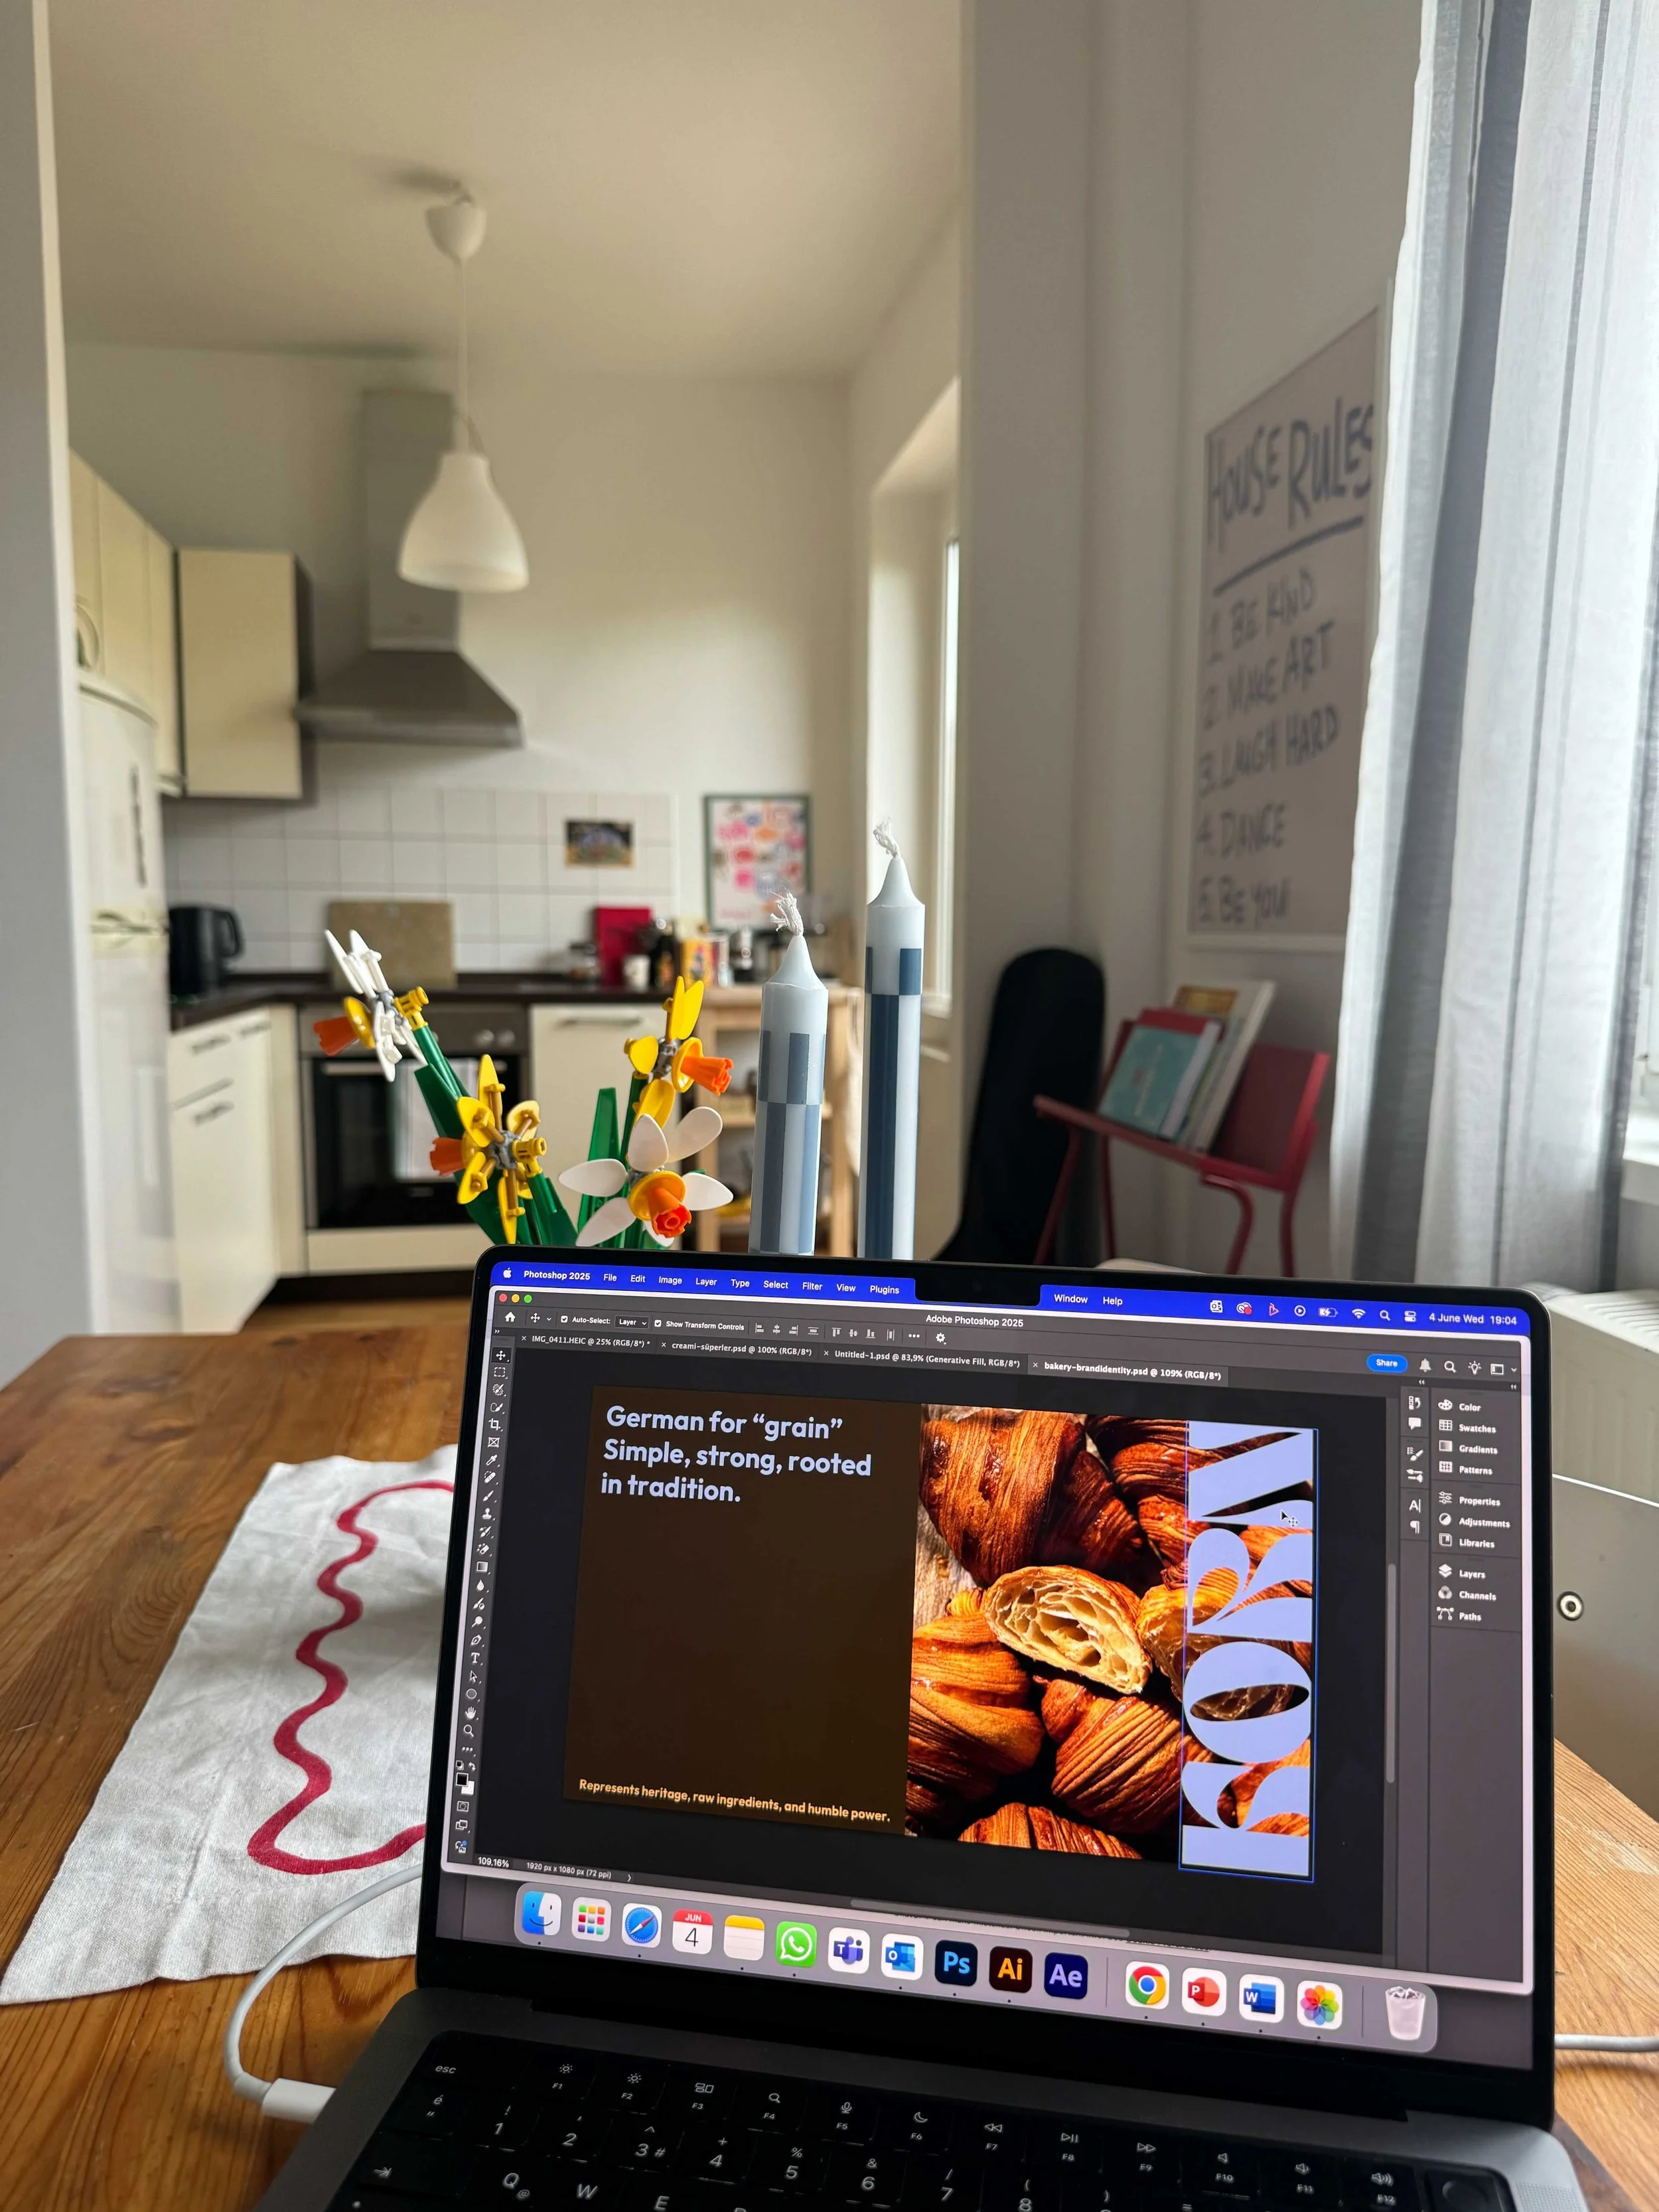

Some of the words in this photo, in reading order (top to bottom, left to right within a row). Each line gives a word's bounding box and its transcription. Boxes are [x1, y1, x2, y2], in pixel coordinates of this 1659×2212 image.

[1206, 425, 1281, 553] HOUSE
[1287, 398, 1373, 530] RULES
[524, 1270, 567, 1280] Photoshop
[569, 1272, 591, 1280] 2025
[658, 1276, 683, 1286] Image
[695, 1278, 717, 1287] Layer
[731, 1279, 750, 1289] Type
[763, 1280, 788, 1290] Select
[802, 1282, 823, 1291] Filter
[836, 1284, 856, 1292] View
[870, 1285, 900, 1295] Plugins
[1054, 1293, 1088, 1303] Window
[1103, 1296, 1123, 1307] Help
[572, 1316, 611, 1325] Auto-Select:
[619, 1319, 637, 1327] Layer
[926, 1314, 952, 1323] Adobe
[955, 1315, 999, 1327] Photoshop
[1001, 1318, 1024, 1327] 2025
[1429, 1312, 1436, 1322] 4
[1437, 1313, 1460, 1323] June
[1463, 1314, 1484, 1324] Wed
[1490, 1315, 1517, 1325] 19:04
[532, 1335, 586, 1345] IMG_0411.HEIC
[757, 1346, 777, 1355] 100%
[835, 1351, 890, 1361] Untitled-1.psd
[926, 1355, 970, 1364] (Generative
[972, 1357, 986, 1366] Fill,
[1376, 1359, 1398, 1367] Share
[1045, 1362, 1148, 1376] bakery-brandidentity.psd
[1459, 1403, 1482, 1412] Color
[607, 1405, 704, 1432] German
[709, 1410, 747, 1434] for
[1459, 1424, 1496, 1434] Swatches
[1459, 1445, 1498, 1455] Gradients
[603, 1438, 691, 1469] Simple,
[695, 1445, 782, 1475] strong,
[788, 1453, 872, 1476] rooted
[1459, 1466, 1492, 1475] Patterns
[601, 1472, 622, 1494] in
[627, 1474, 741, 1502] tradition.
[1459, 1496, 1501, 1507] Properties
[1459, 1517, 1510, 1528] Adjustments
[1459, 1538, 1495, 1548] Libraries
[1459, 1570, 1486, 1580] Layers
[1459, 1591, 1496, 1601] Channels
[1459, 1612, 1482, 1621] Paths
[579, 1779, 640, 1795] Represents
[642, 1785, 691, 1803] heritage,
[693, 1793, 715, 1803] raw
[717, 1793, 782, 1812] ingredients,
[784, 1802, 806, 1813] and
[808, 1803, 849, 1818] humble
[851, 1809, 891, 1822] power.
[526, 1862, 542, 1870] 1920
[543, 1864, 552, 1873] px
[559, 1866, 575, 1874] 1080
[586, 1868, 597, 1877] (72
[598, 1870, 612, 1880] ppi)
[685, 1913, 701, 1922] JUN
[685, 1927, 699, 1947] 4
[838, 1944, 845, 1955] T
[944, 1951, 970, 1974] Ps
[997, 1957, 1023, 1980] Ai
[1048, 1964, 1083, 1988] Ae
[1192, 1985, 1200, 1997] P
[1246, 1992, 1258, 2003] W
[435, 2065, 457, 2075] esc
[551, 2082, 563, 2091] F1
[620, 2092, 634, 2101] F2
[494, 2122, 504, 2135] 1
[835, 2122, 849, 2131] F5
[561, 2132, 579, 2147] 2
[910, 2132, 923, 2141] F6
[634, 2143, 651, 2158] 3
[985, 2143, 998, 2152] F7
[709, 2154, 724, 2168] 4
[1062, 2153, 1076, 2162] F8
[784, 2165, 800, 2180] 5
[1139, 2163, 1153, 2172] F9
[502, 2173, 521, 2190] Q
[861, 2175, 876, 2191] 6
[1215, 2173, 1235, 2184] F10
[575, 2183, 599, 2201] W
[940, 2186, 954, 2202] 7
[1296, 2184, 1315, 2195] F11
[653, 2195, 670, 2212] E
[1017, 2197, 1033, 2212] 8
[1376, 2194, 1397, 2207] F12
